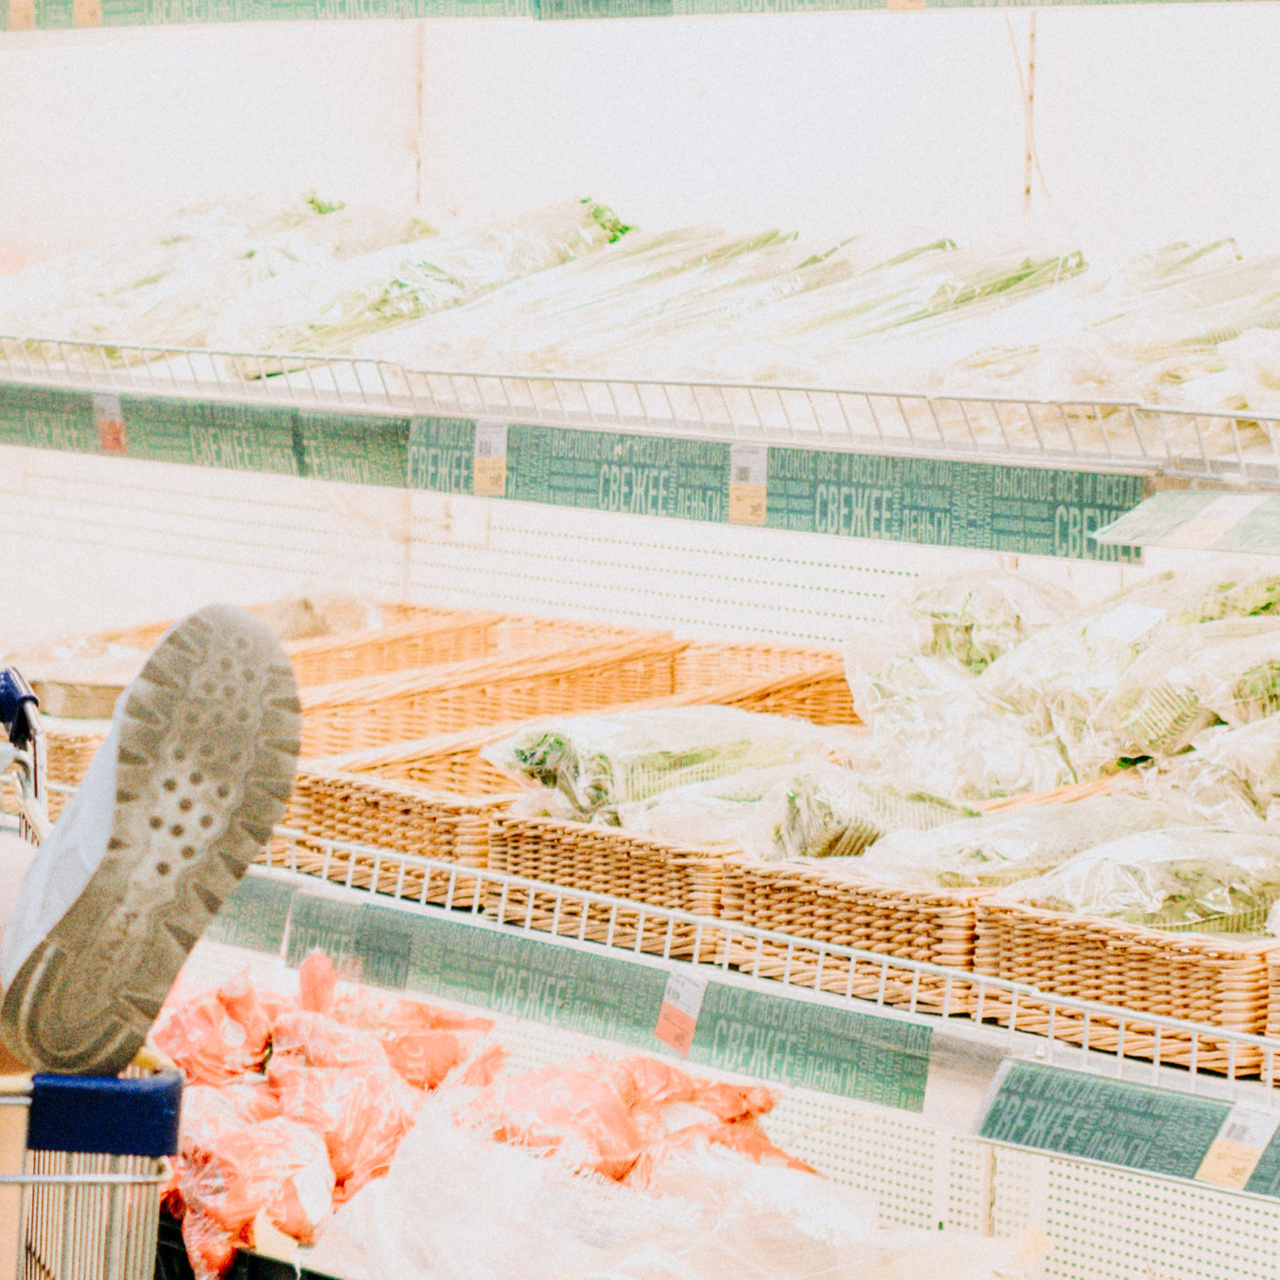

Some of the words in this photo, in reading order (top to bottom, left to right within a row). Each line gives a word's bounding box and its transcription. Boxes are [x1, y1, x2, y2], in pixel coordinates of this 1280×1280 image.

[599, 463, 669, 516] СВЕЖЕЕ
[816, 484, 892, 539] СВЕЖЕЕ
[491, 964, 567, 1026] СВЕЖЕЕ
[712, 1018, 799, 1086] СВЕЖЕЕ
